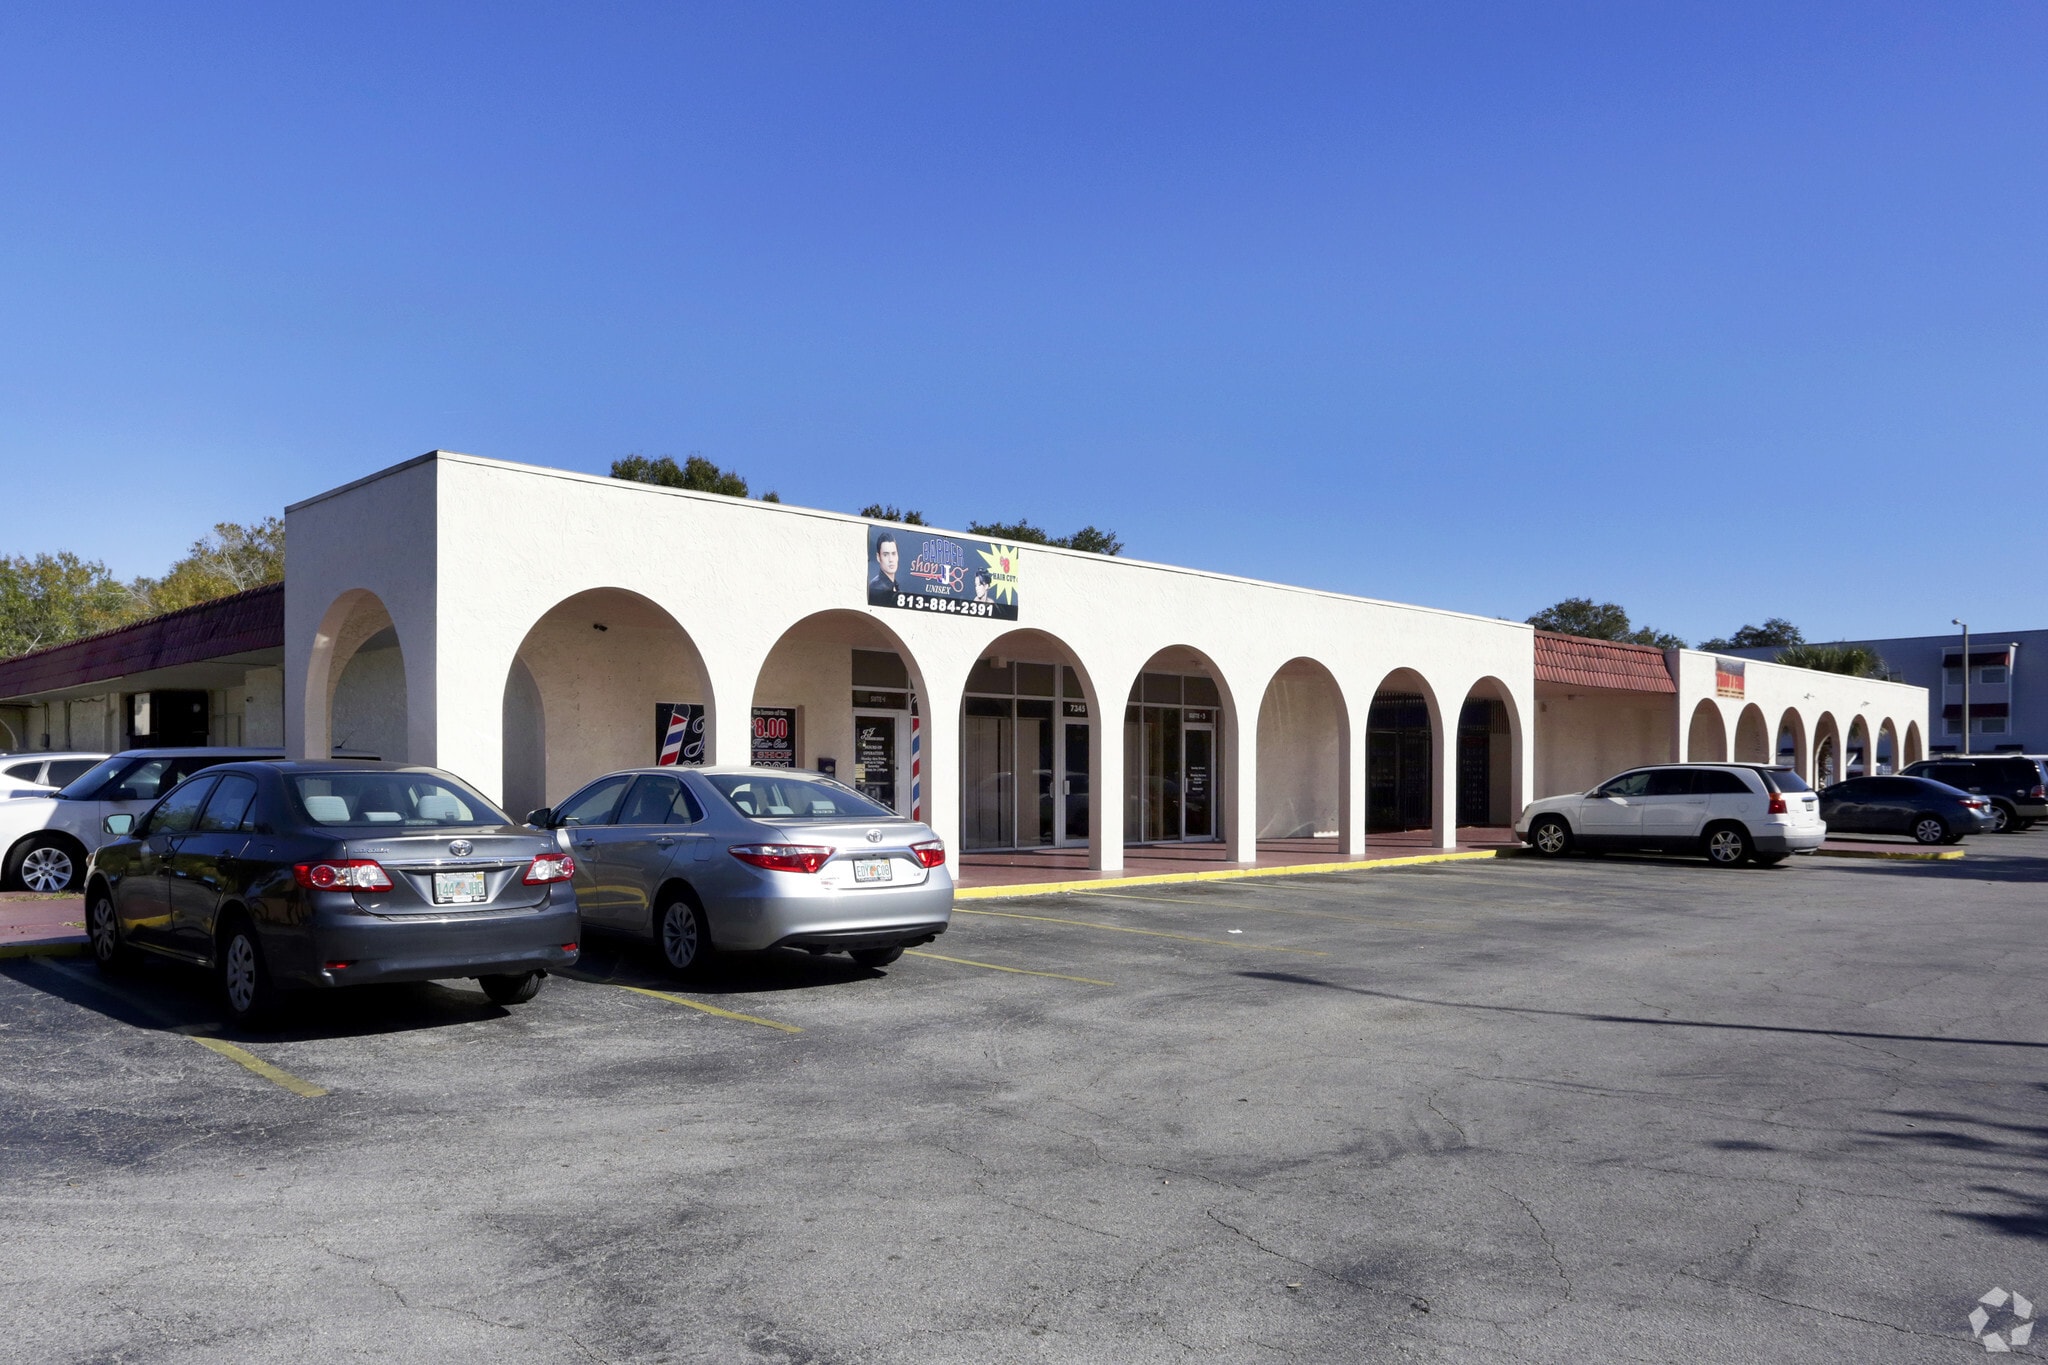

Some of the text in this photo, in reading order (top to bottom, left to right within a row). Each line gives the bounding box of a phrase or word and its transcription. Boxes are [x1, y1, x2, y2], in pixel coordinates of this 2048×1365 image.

[923, 539, 964, 566] BARBER
[911, 555, 938, 573] shop
[992, 573, 1016, 583] HAIR CUT
[926, 585, 951, 594] UNISEX
[897, 595, 993, 616] 813-884-2391
[1070, 704, 1086, 713] 7345
[773, 738, 788, 749] Cut
[757, 751, 792, 759] SHOP
[437, 881, 483, 896] 144 JHG
